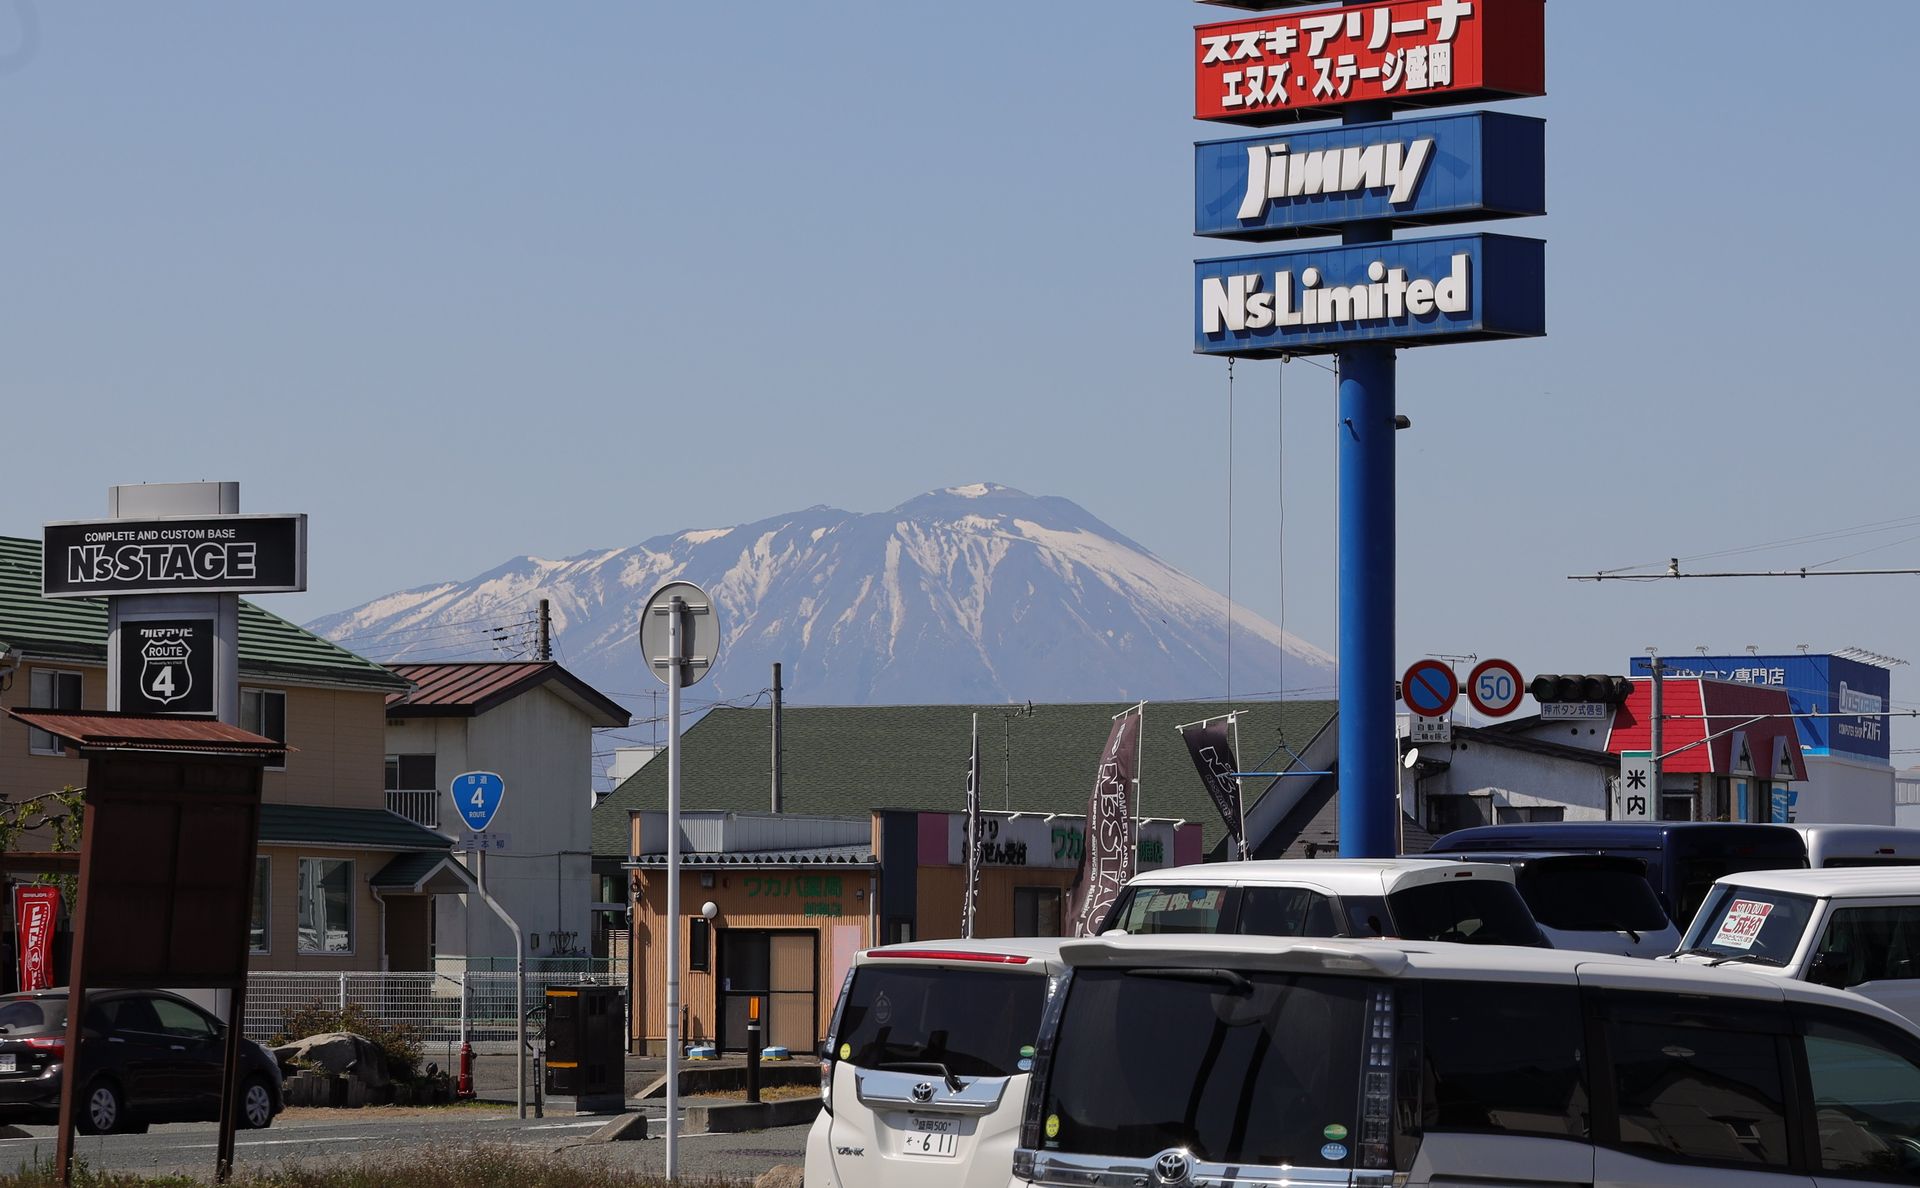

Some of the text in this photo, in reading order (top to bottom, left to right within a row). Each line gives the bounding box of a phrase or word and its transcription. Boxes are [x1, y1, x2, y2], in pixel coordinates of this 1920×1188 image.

[1201, 0, 1471, 63] スズキアリーナ
[1222, 43, 1451, 106] エヌズ・ステージ盛岡
[85, 529, 236, 542] COMPLETE AND CUSTOM BASE
[149, 646, 183, 656] ROUTE
[152, 666, 175, 696] 4
[1480, 676, 1511, 701] 50
[1543, 703, 1604, 716] 押ボタン式信号
[1413, 733, 1448, 741] 二輪を除く
[1417, 723, 1444, 731] 自動車
[471, 787, 484, 808] 4
[1722, 914, 1763, 937] ご成約
